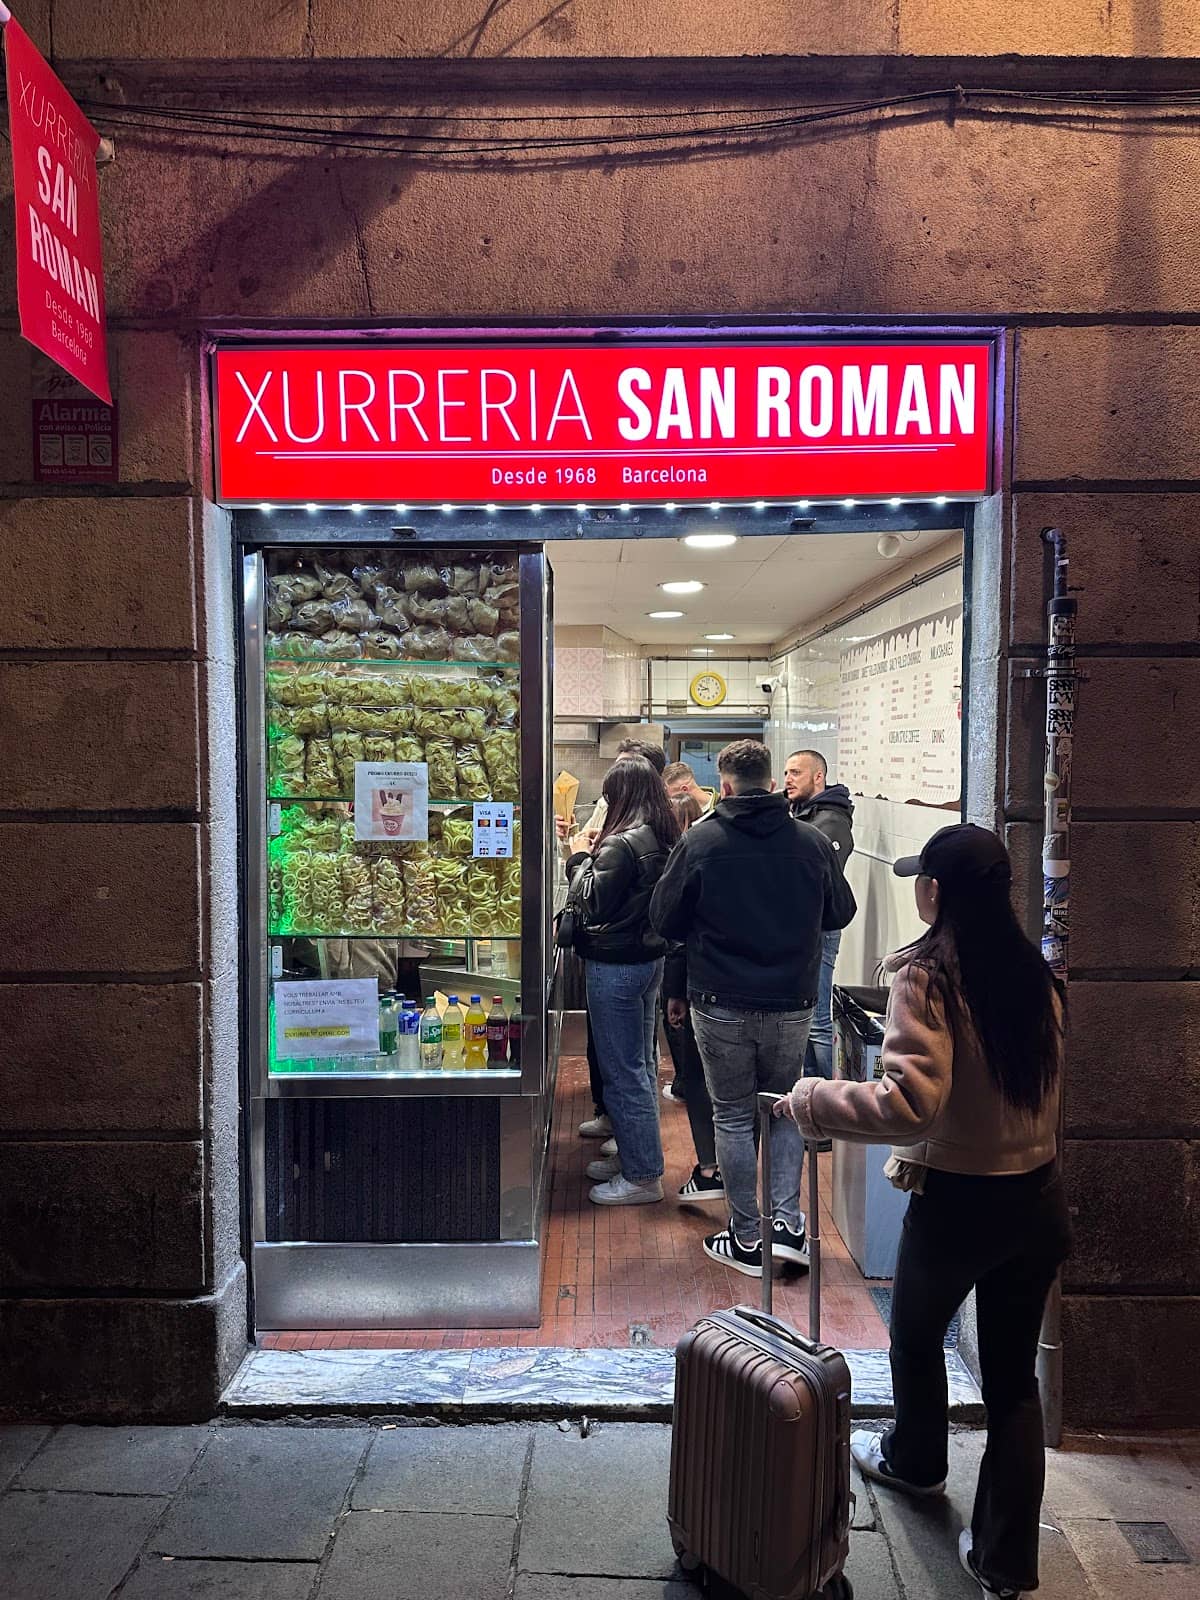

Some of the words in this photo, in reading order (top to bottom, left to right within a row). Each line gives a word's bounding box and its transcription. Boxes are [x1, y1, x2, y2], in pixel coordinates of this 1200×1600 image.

[19, 71, 90, 192] XURRERIA
[38, 146, 78, 237] SAN
[29, 203, 100, 324] ROMAN
[45, 290, 73, 328] Desde
[76, 319, 93, 350] 1968
[52, 320, 87, 365] Barcelona
[40, 402, 112, 421] Alarma
[235, 369, 592, 443] XURRERIA
[618, 365, 735, 440] SAN
[758, 363, 976, 438] ROMAN
[492, 468, 547, 485] Desde
[556, 467, 596, 484] 1968
[622, 466, 708, 483] Barcelona
